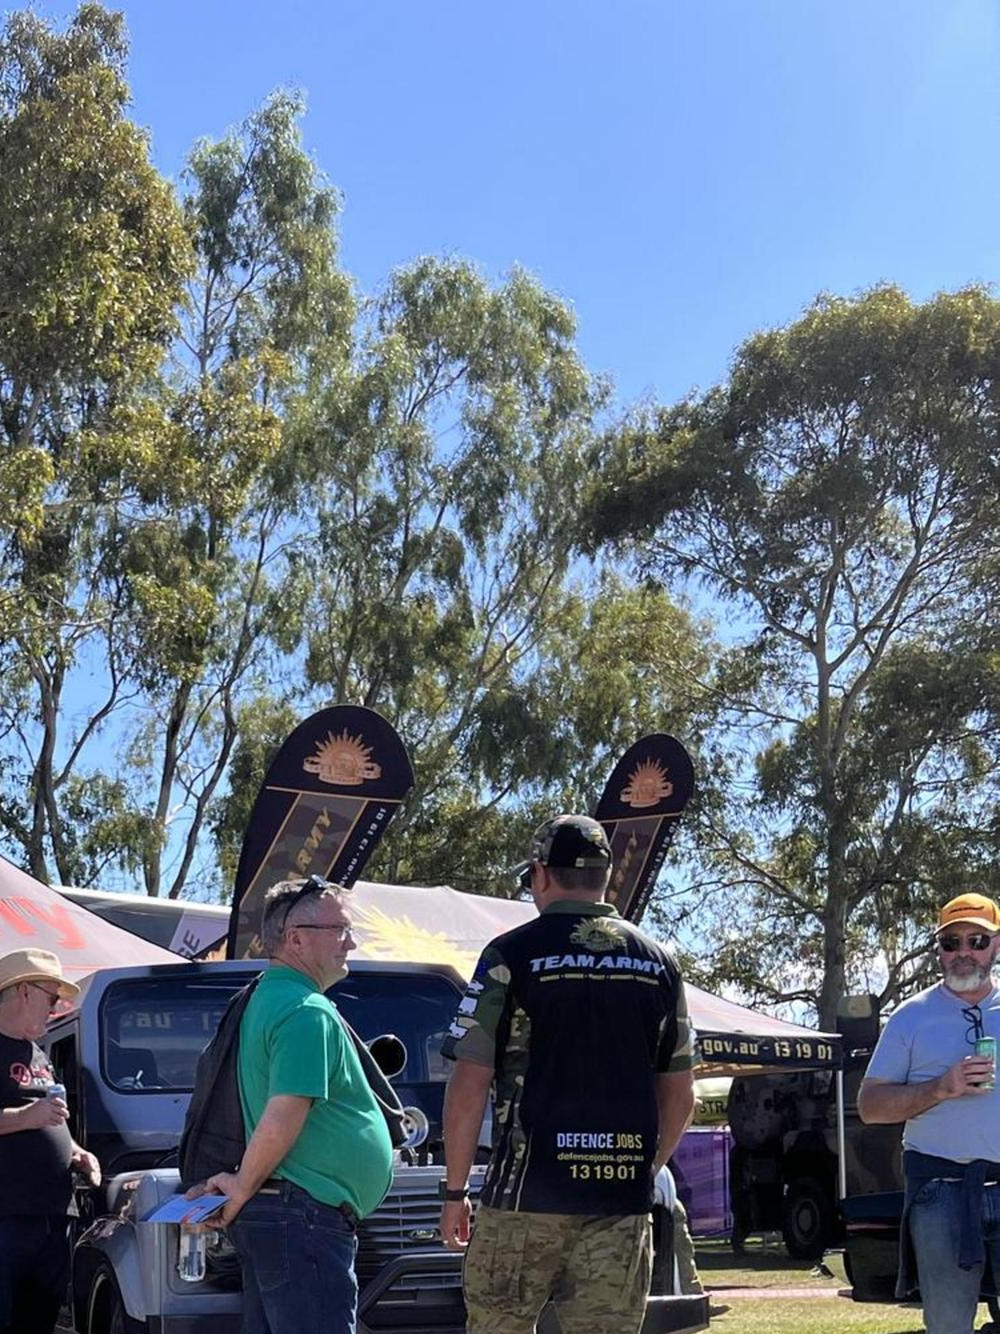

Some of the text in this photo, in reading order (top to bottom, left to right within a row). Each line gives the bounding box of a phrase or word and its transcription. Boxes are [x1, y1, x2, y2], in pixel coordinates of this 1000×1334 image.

[529, 954, 665, 976] TEAM ARMY
[774, 1041, 791, 1058] 13
[796, 1043, 812, 1059] 19
[817, 1044, 833, 1060] 01
[557, 1133, 643, 1149] DEFENCE JOBS
[557, 1152, 644, 1164] defencejobs.gov.au
[569, 1164, 636, 1180] 13 19 01
